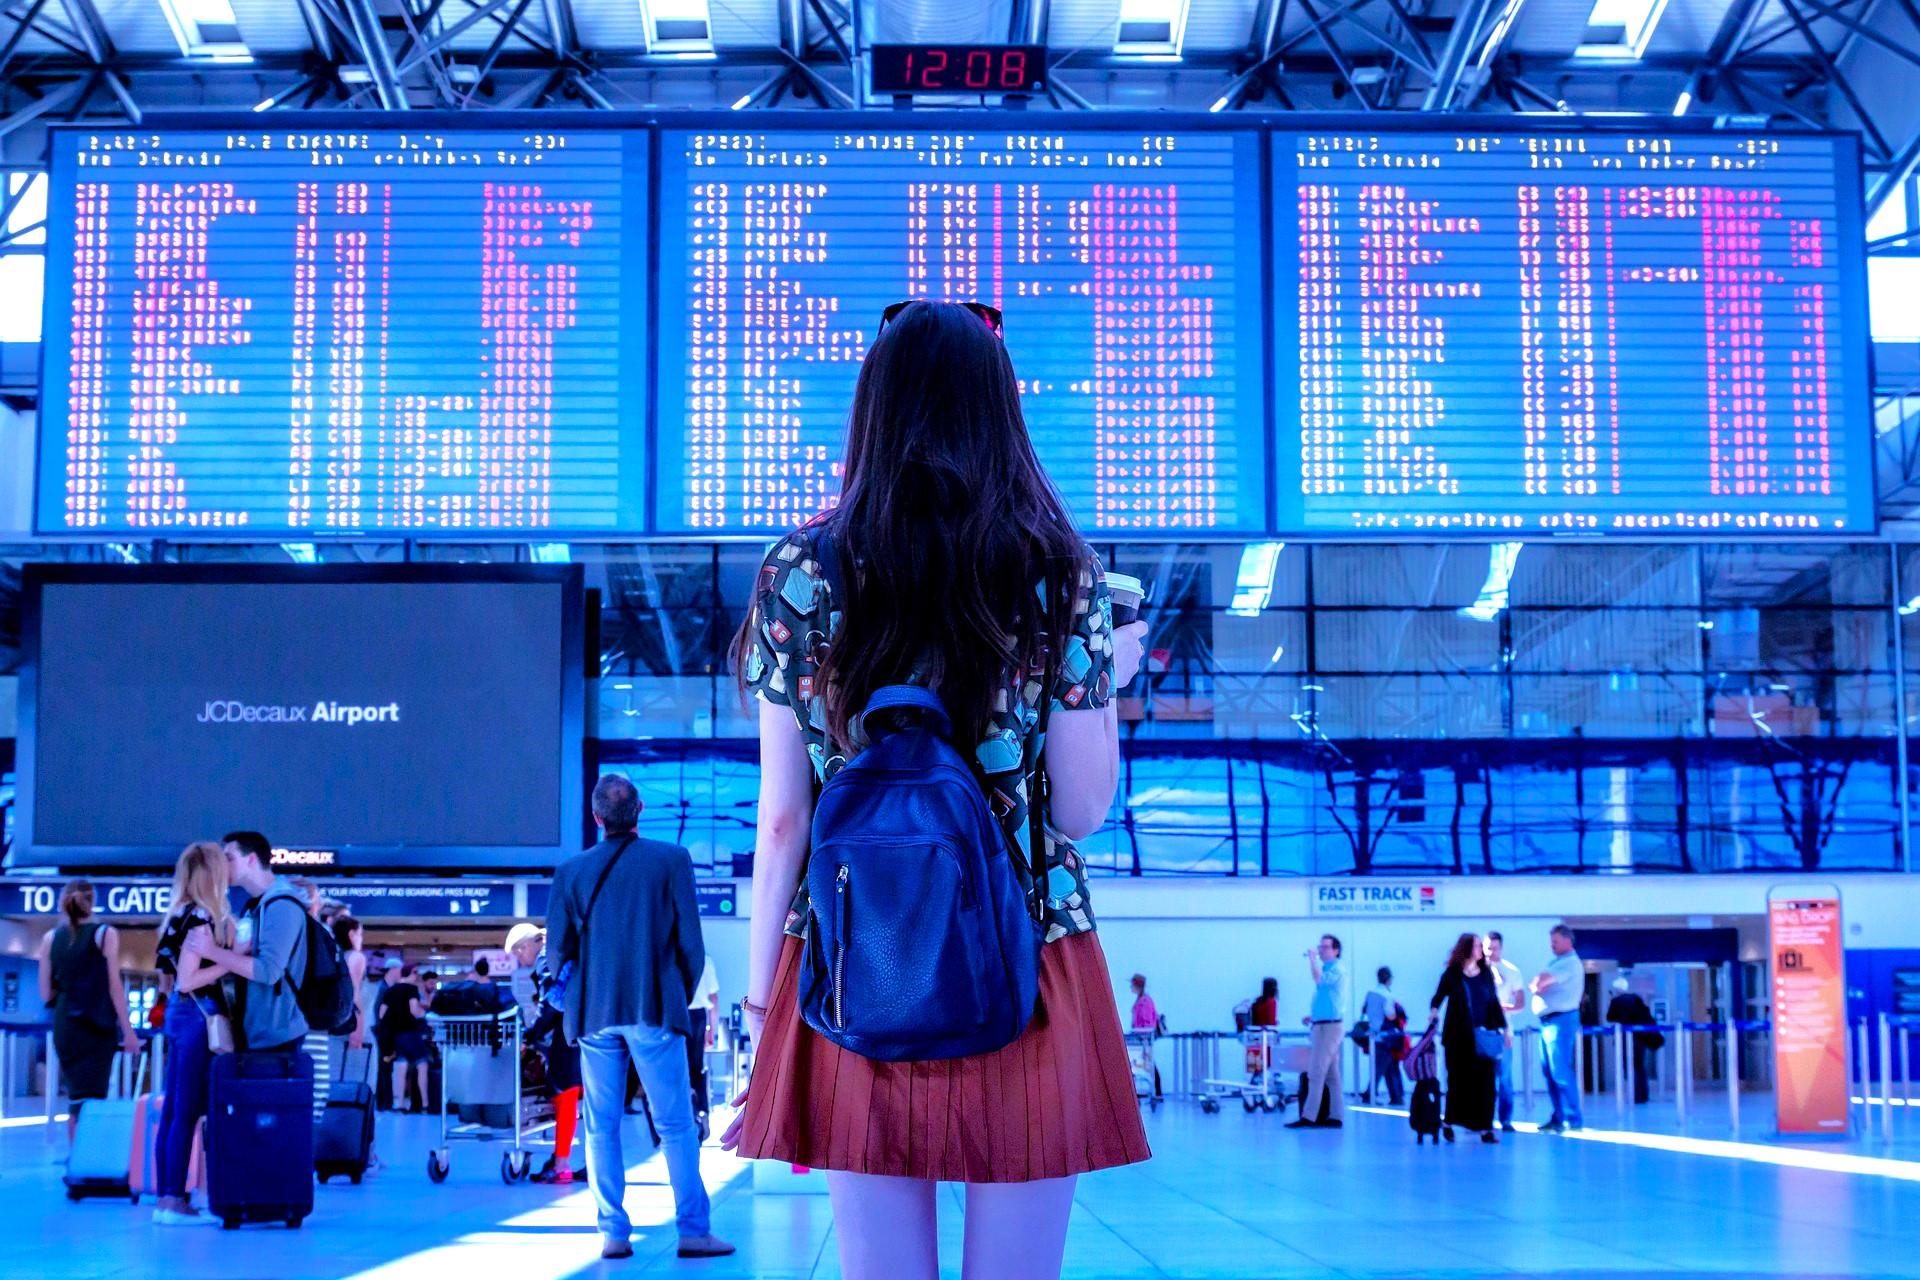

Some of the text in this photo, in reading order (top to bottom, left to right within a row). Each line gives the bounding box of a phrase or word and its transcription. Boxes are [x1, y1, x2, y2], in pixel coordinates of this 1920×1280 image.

[905, 49, 1026, 88] 12:08
[197, 700, 400, 726] JCDecaux Airport
[269, 848, 335, 864] Decaux
[20, 886, 55, 913] TO
[108, 886, 171, 913] GATE
[327, 887, 348, 897] YOUR
[349, 887, 387, 897] PASSPORT
[388, 887, 404, 897] AND
[405, 887, 444, 898] BOARDING
[445, 887, 463, 898] PASS
[464, 887, 490, 898] READY
[1319, 887, 1413, 901] FAST TRACK
